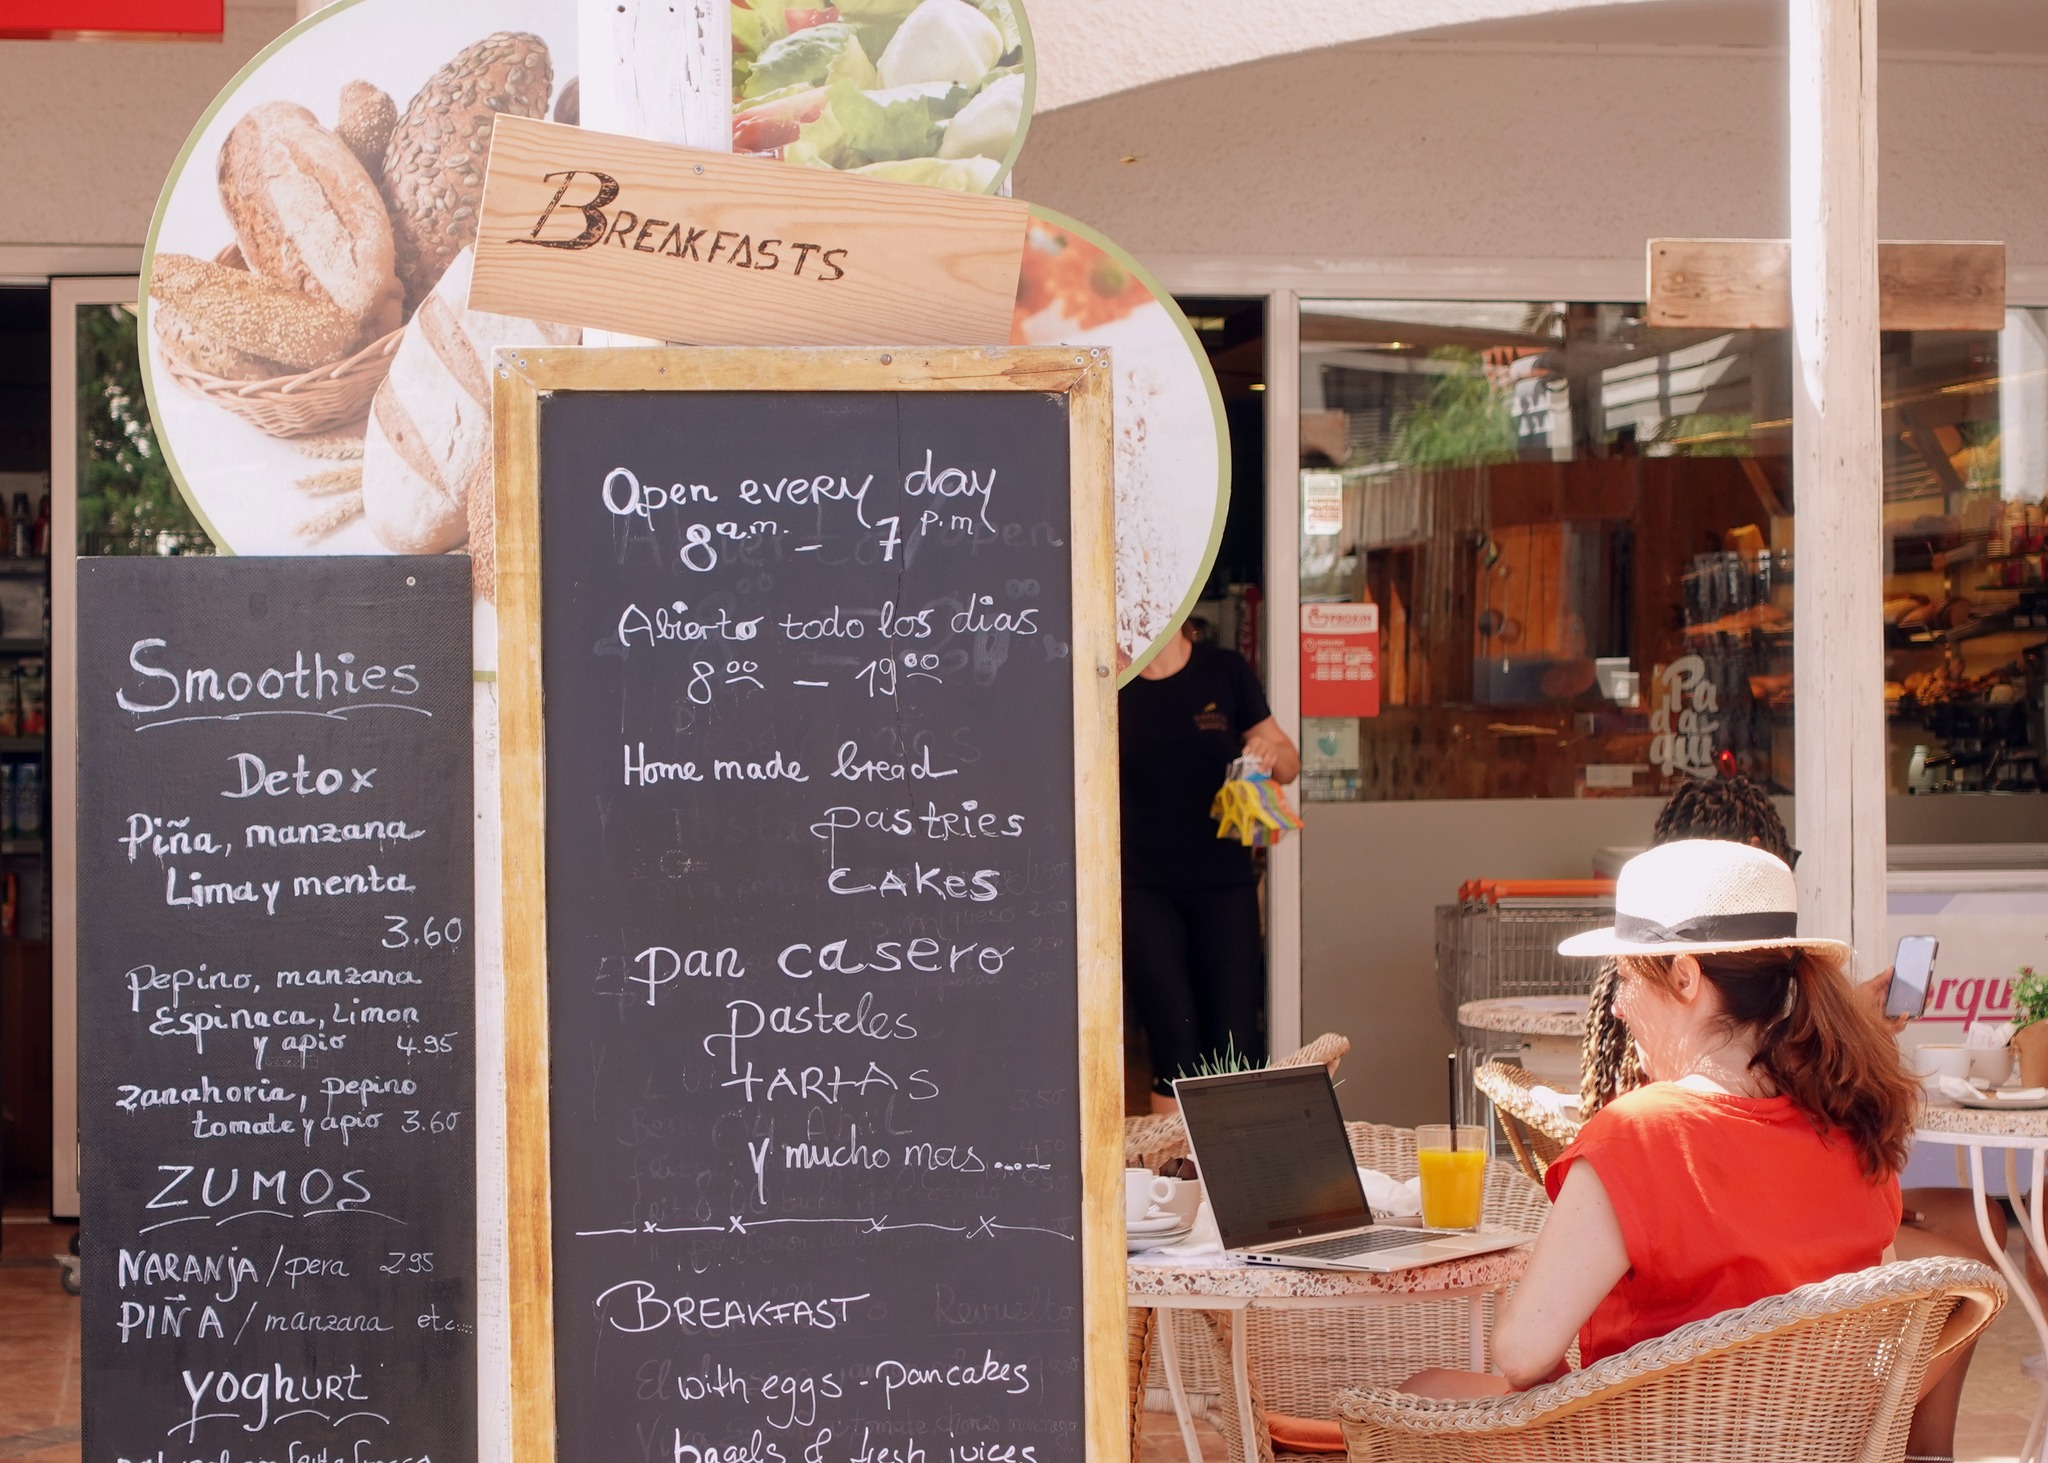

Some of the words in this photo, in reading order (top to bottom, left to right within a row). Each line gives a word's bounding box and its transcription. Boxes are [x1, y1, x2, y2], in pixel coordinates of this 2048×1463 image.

[506, 170, 848, 281] BREAKFASTS
[602, 467, 717, 531] Open
[904, 449, 996, 532] day
[875, 517, 902, 562] 7
[618, 601, 764, 647] Abierto
[779, 605, 864, 641] todo
[878, 601, 934, 639] los
[951, 594, 1038, 635] dias
[115, 638, 420, 712] Smoothies
[220, 753, 377, 798] Detox
[623, 742, 703, 785] Home
[714, 752, 809, 782] made
[832, 741, 958, 782] bread
[246, 820, 425, 849] manzana
[167, 867, 258, 908] Lima
[293, 866, 415, 897] menta
[381, 915, 462, 952] 3.60
[277, 967, 422, 987] manzana
[778, 939, 1014, 978] casero
[281, 1032, 346, 1069] apio
[397, 1032, 458, 1056] 4.95
[192, 1110, 295, 1138] tomate
[321, 1111, 382, 1146] apio
[402, 1111, 461, 1133] 3.60
[786, 1124, 891, 1171] mucho
[146, 1165, 371, 1210] ZUMOS
[117, 1294, 224, 1343] PIÑA
[264, 1310, 393, 1332] manzana
[597, 1280, 870, 1332] BREAKFAST
[678, 1364, 750, 1403] with
[761, 1380, 843, 1428] eggs
